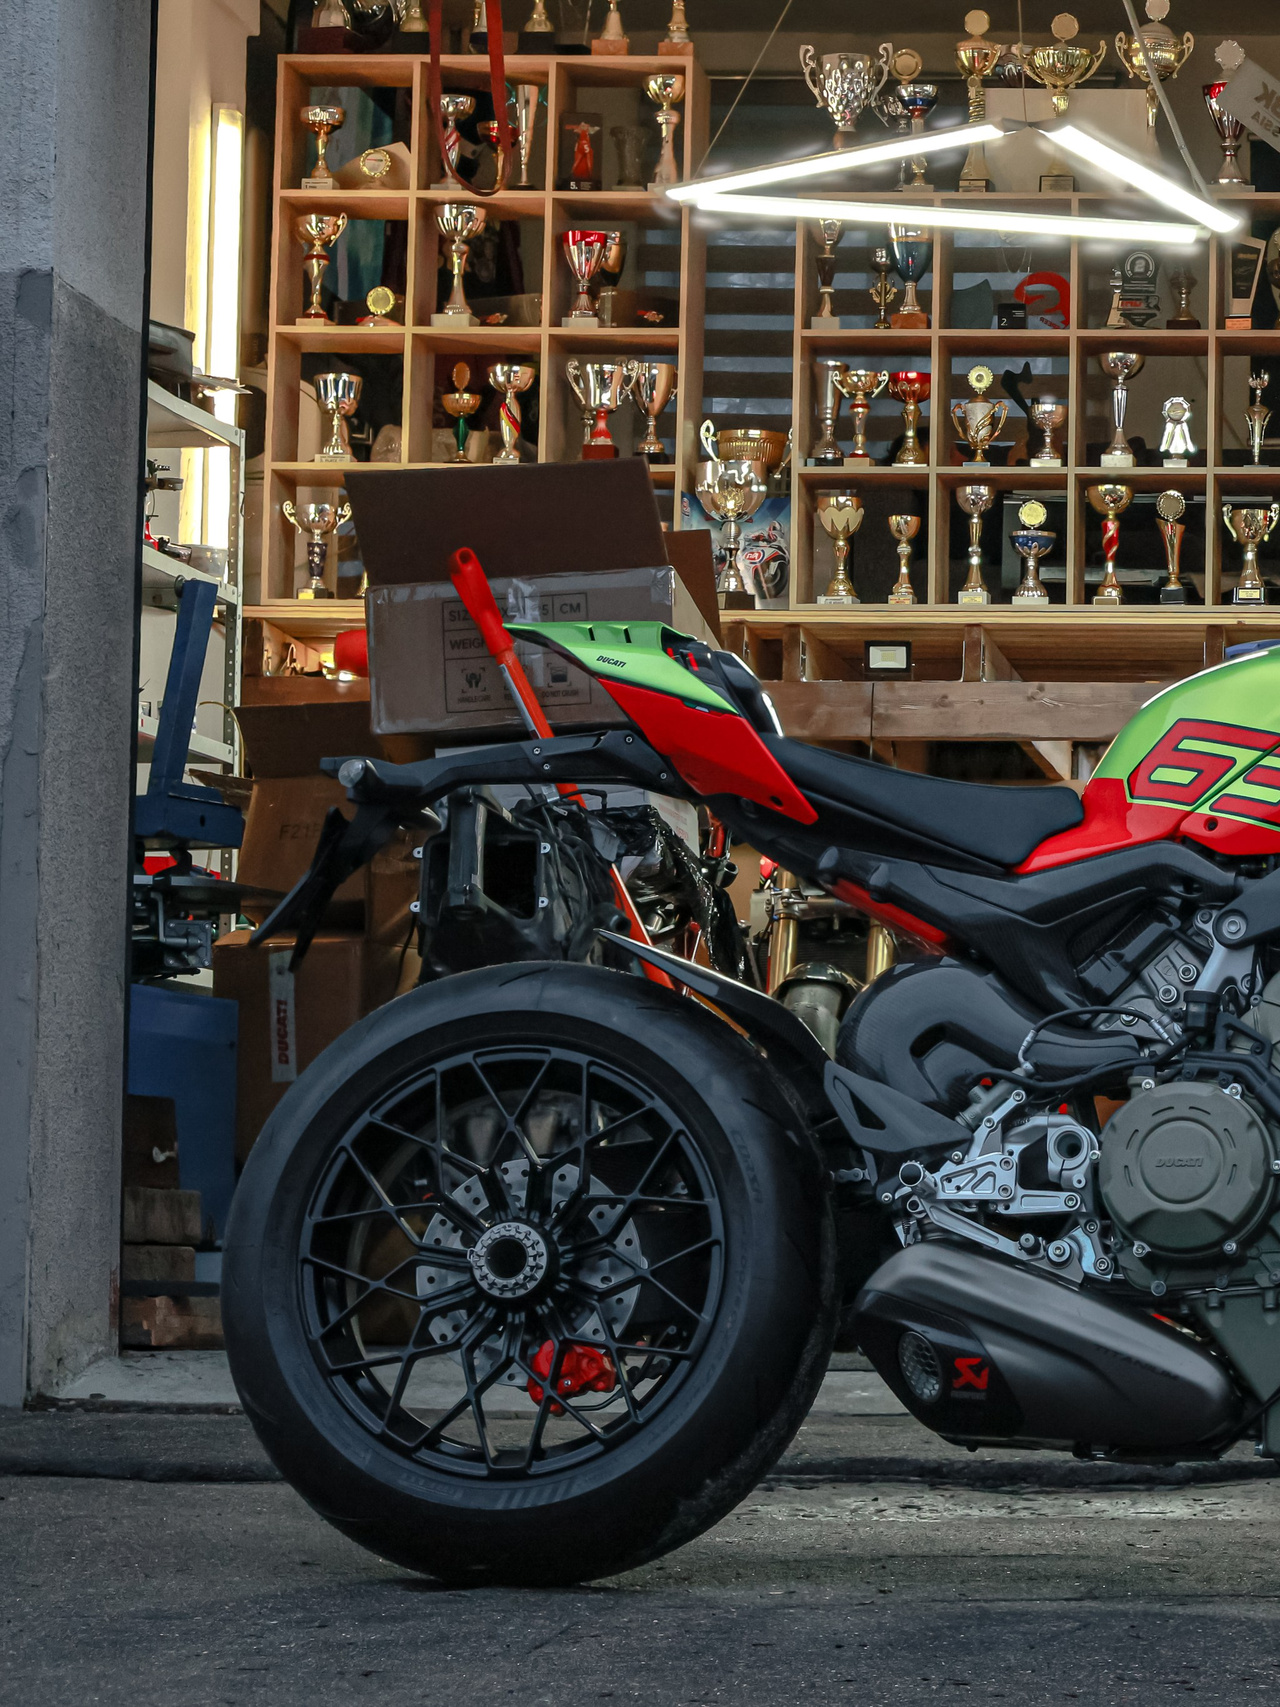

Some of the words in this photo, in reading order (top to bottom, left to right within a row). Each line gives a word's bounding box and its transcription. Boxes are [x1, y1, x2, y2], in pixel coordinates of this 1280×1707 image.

[1134, 259, 1146, 273] 2
[559, 602, 582, 614] CM
[596, 655, 627, 668] DUCATI
[277, 999, 289, 1065] DUCATI
[1155, 1156, 1205, 1168] DUCATI
